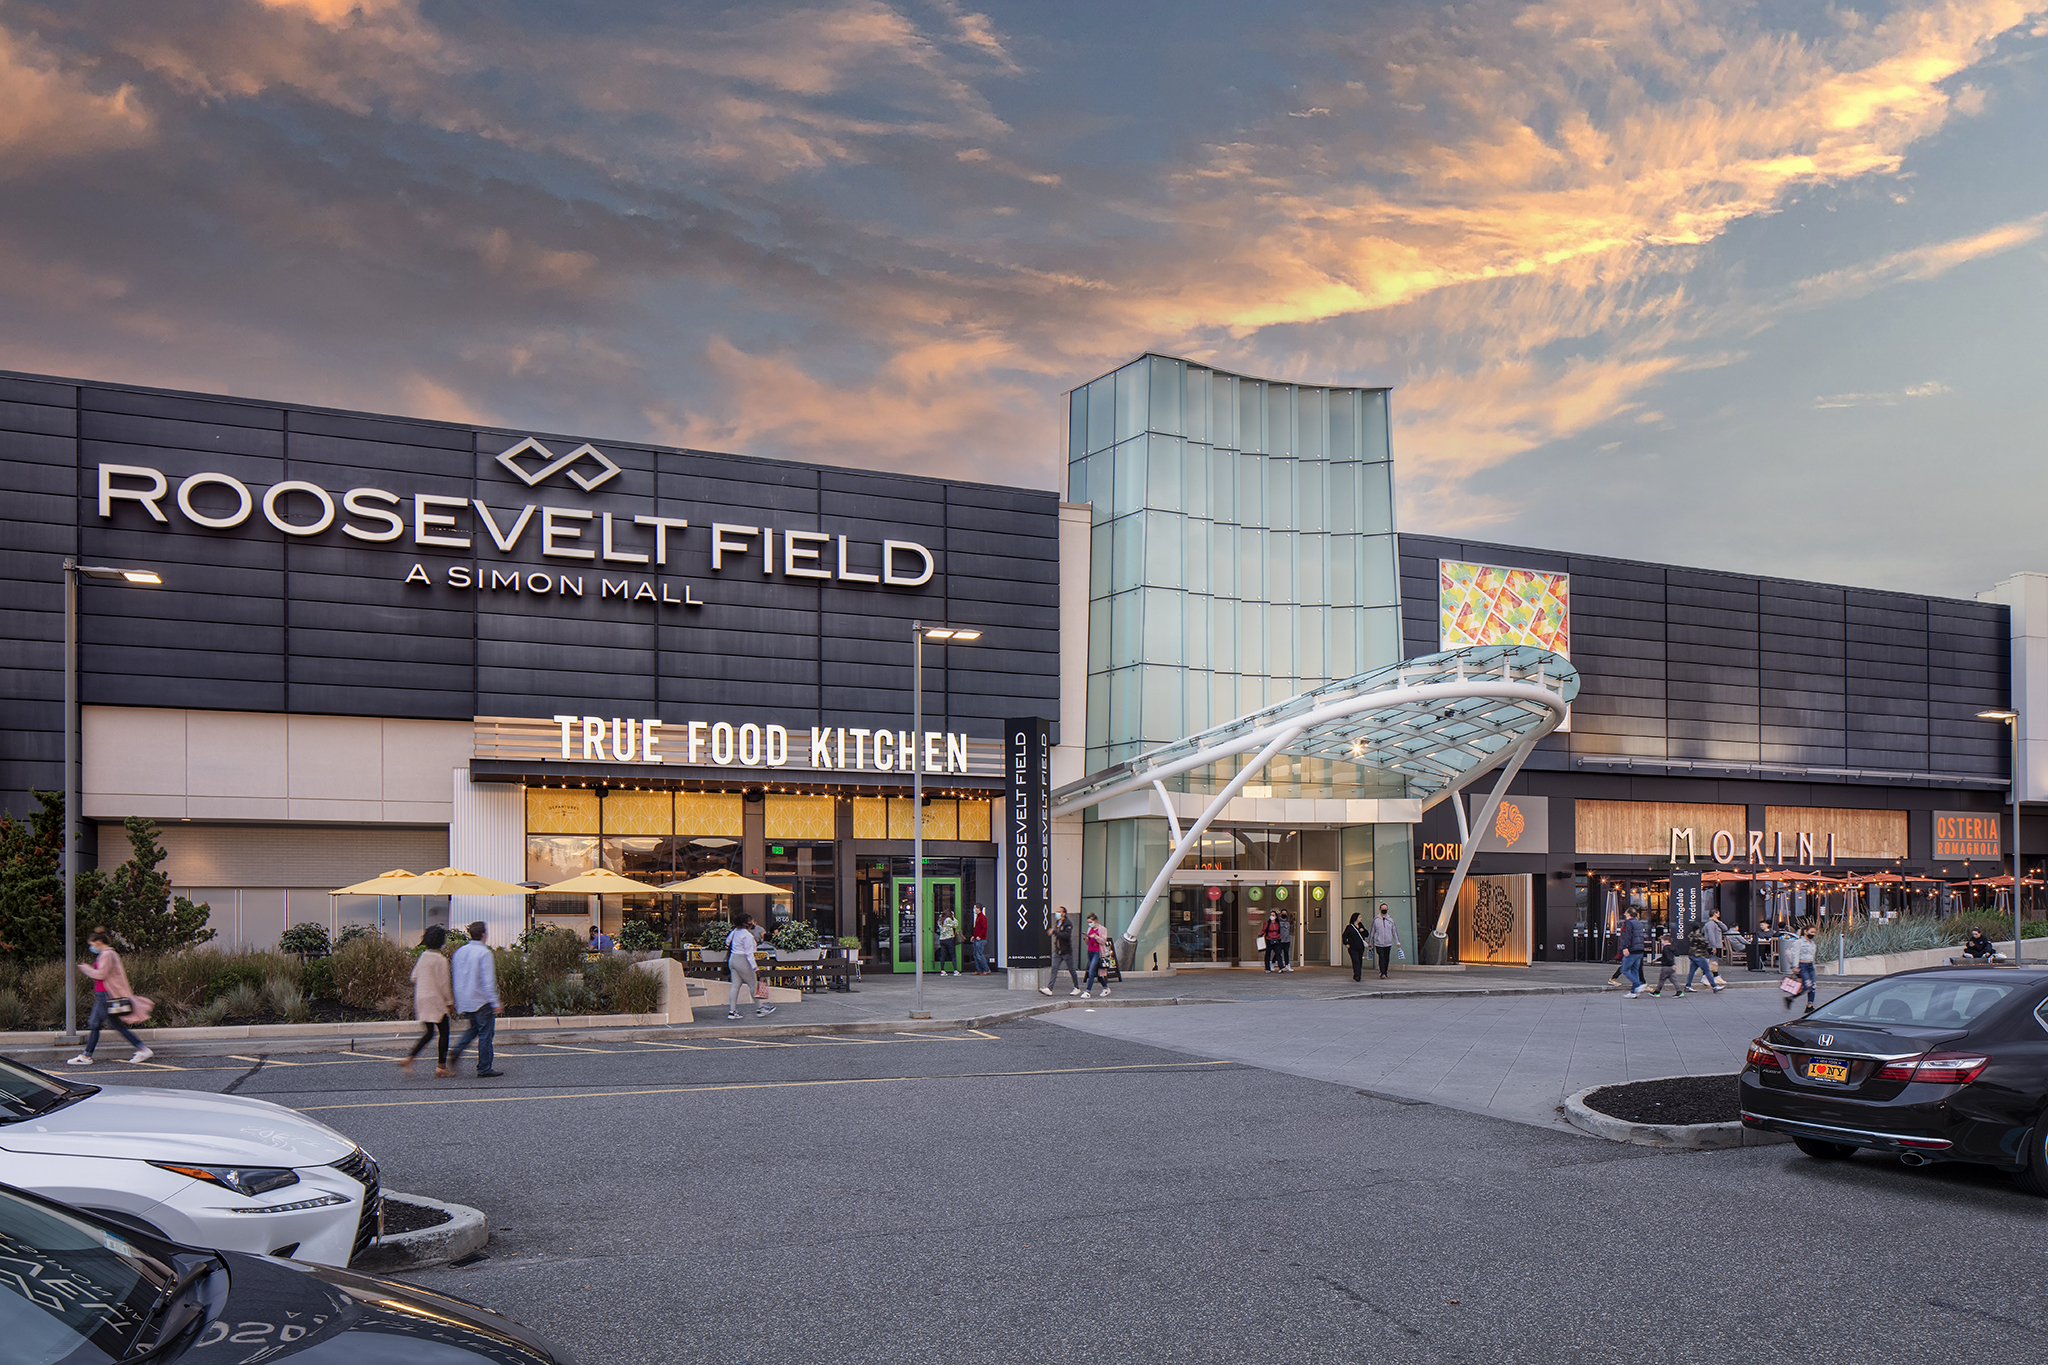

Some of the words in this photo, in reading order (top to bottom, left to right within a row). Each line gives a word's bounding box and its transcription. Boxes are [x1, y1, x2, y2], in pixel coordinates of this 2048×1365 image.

[98, 462, 688, 566] ROOSEVELT
[711, 521, 935, 588] FIELD
[404, 563, 431, 586] A
[447, 565, 584, 597] SIMON
[601, 577, 704, 605] MALL
[553, 715, 663, 763] TRUE
[687, 720, 788, 766] FOOD
[810, 726, 967, 773] KITCHEN
[1014, 731, 1027, 785] FIELD
[1015, 788, 1028, 900] ROOSEVELT
[1041, 788, 1049, 900] ROOSEVELT
[1669, 827, 1835, 866] MORINI
[1937, 817, 1998, 840] OSTERIA
[1937, 842, 1998, 855] ROMAGNOLA
[1675, 887, 1686, 940] Bloomingdale's
[1811, 1064, 1817, 1073] I
[1826, 1066, 1846, 1076] NY
